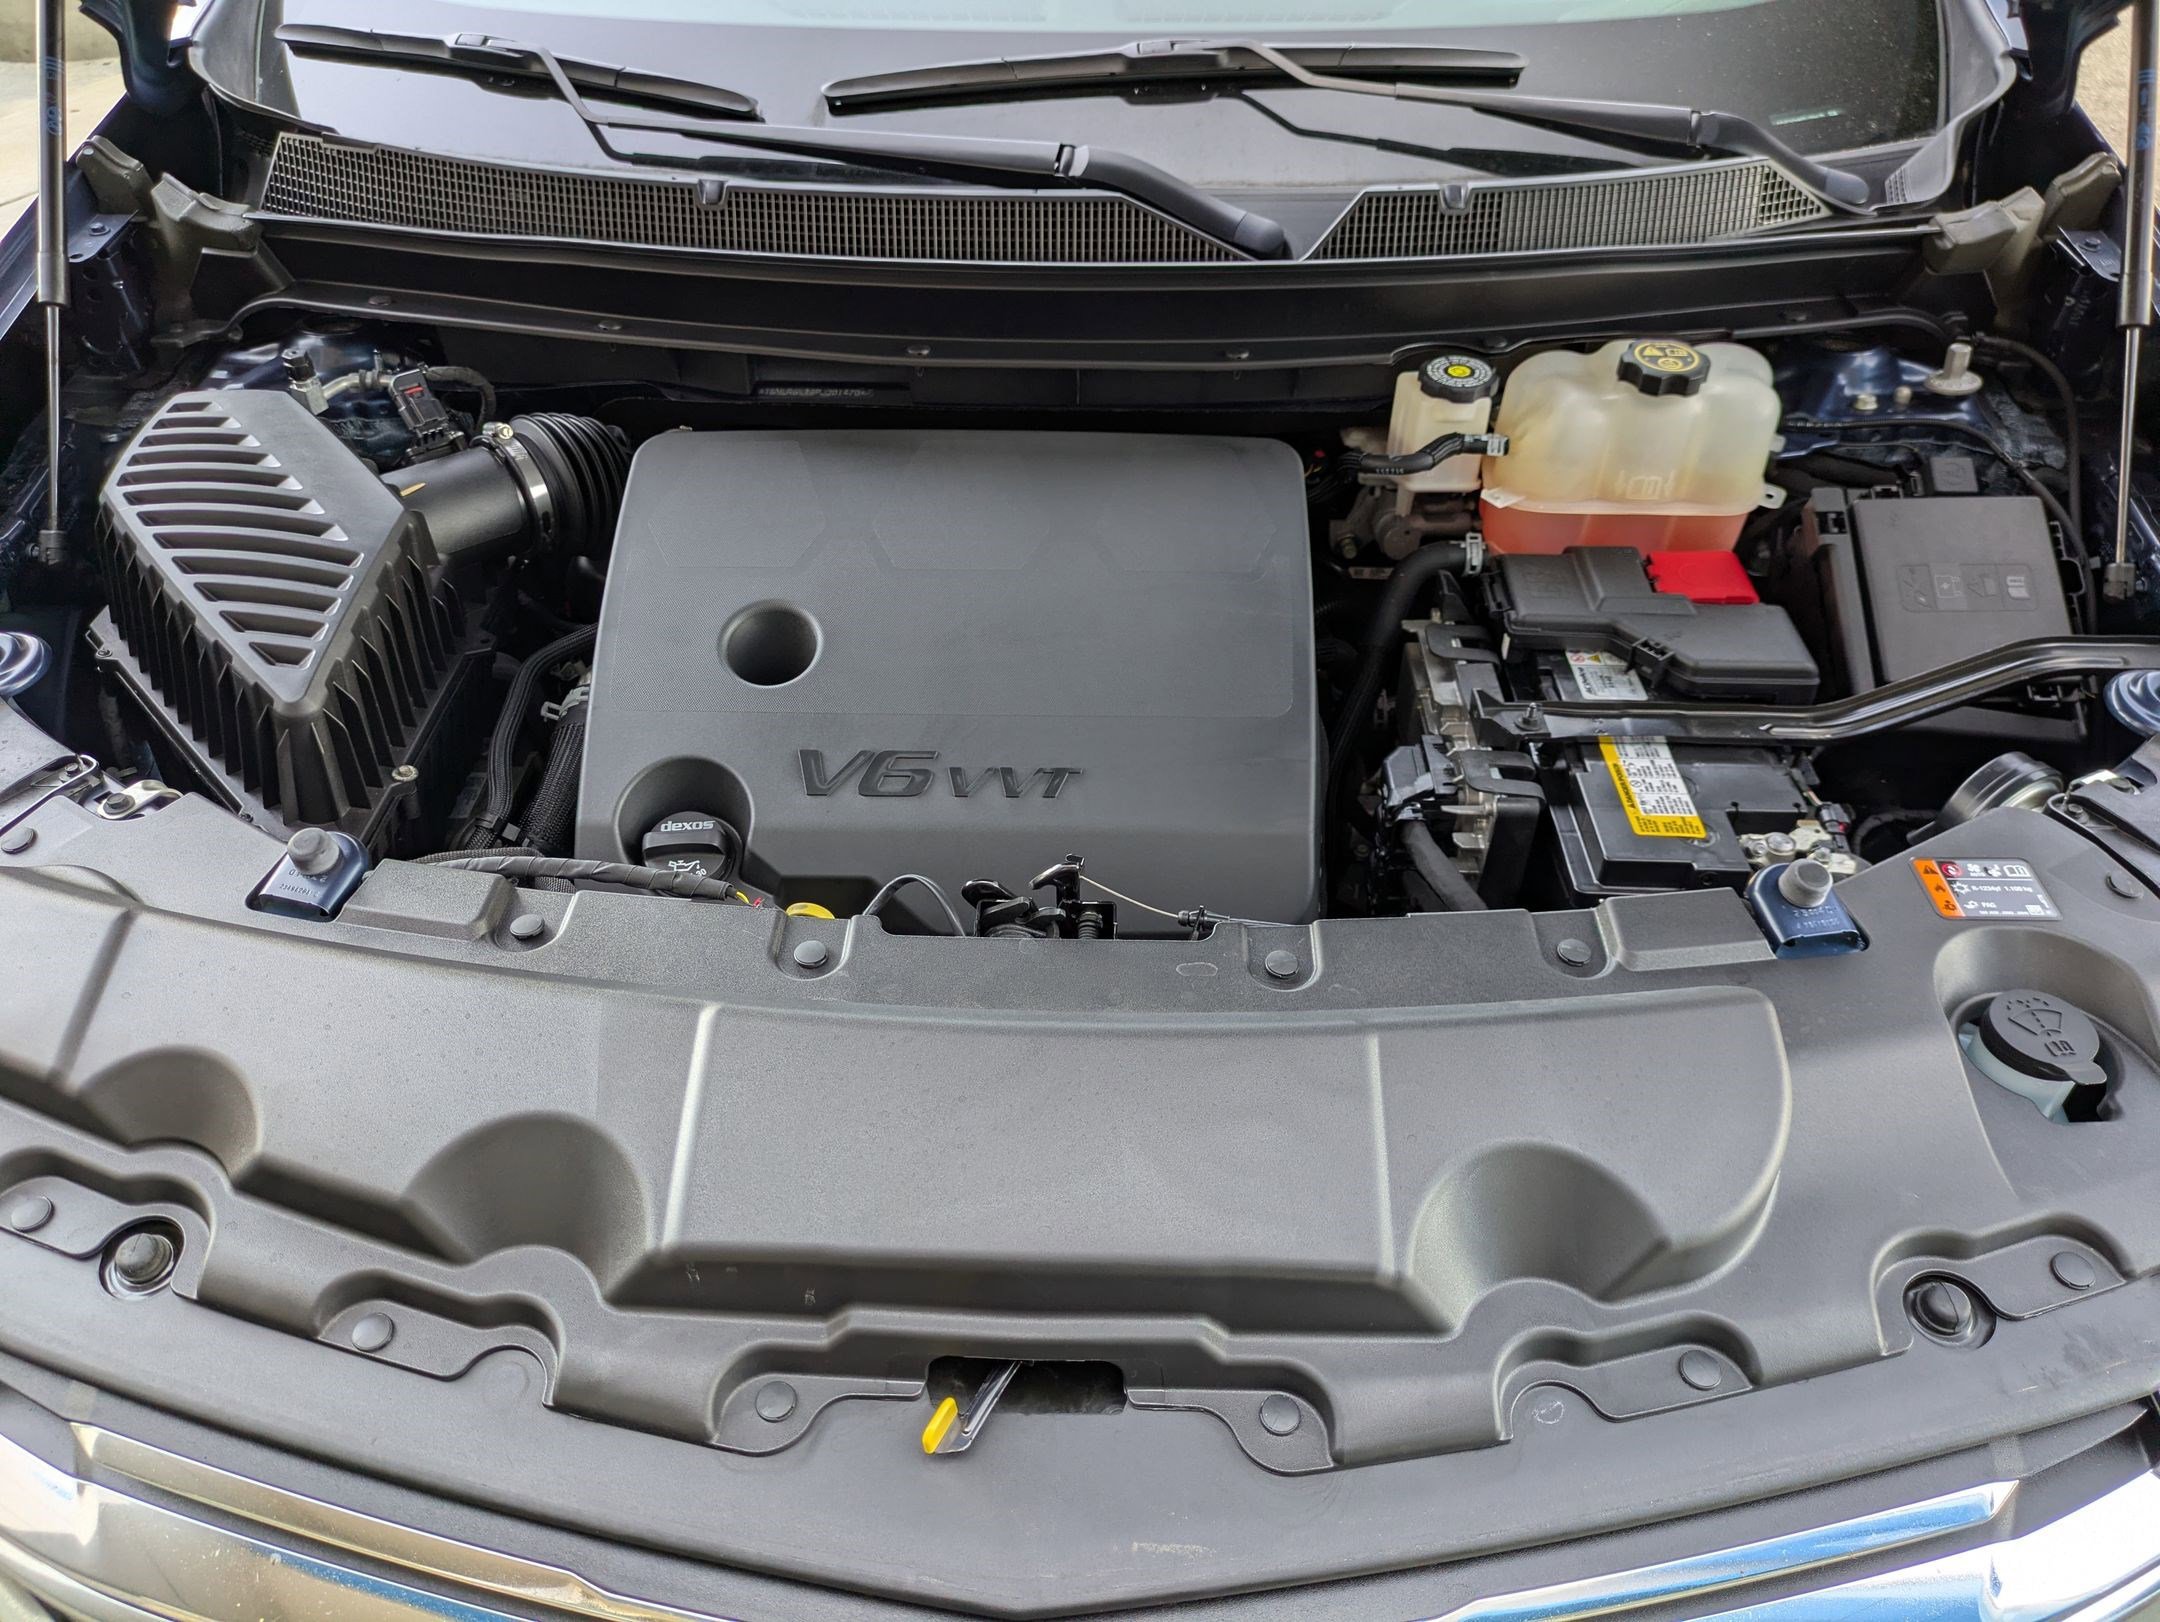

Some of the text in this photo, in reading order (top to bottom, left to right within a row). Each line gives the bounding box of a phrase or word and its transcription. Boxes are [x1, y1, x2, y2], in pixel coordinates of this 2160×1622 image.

[797, 748, 1085, 799] V6 VVT
[660, 820, 716, 832] dexos
